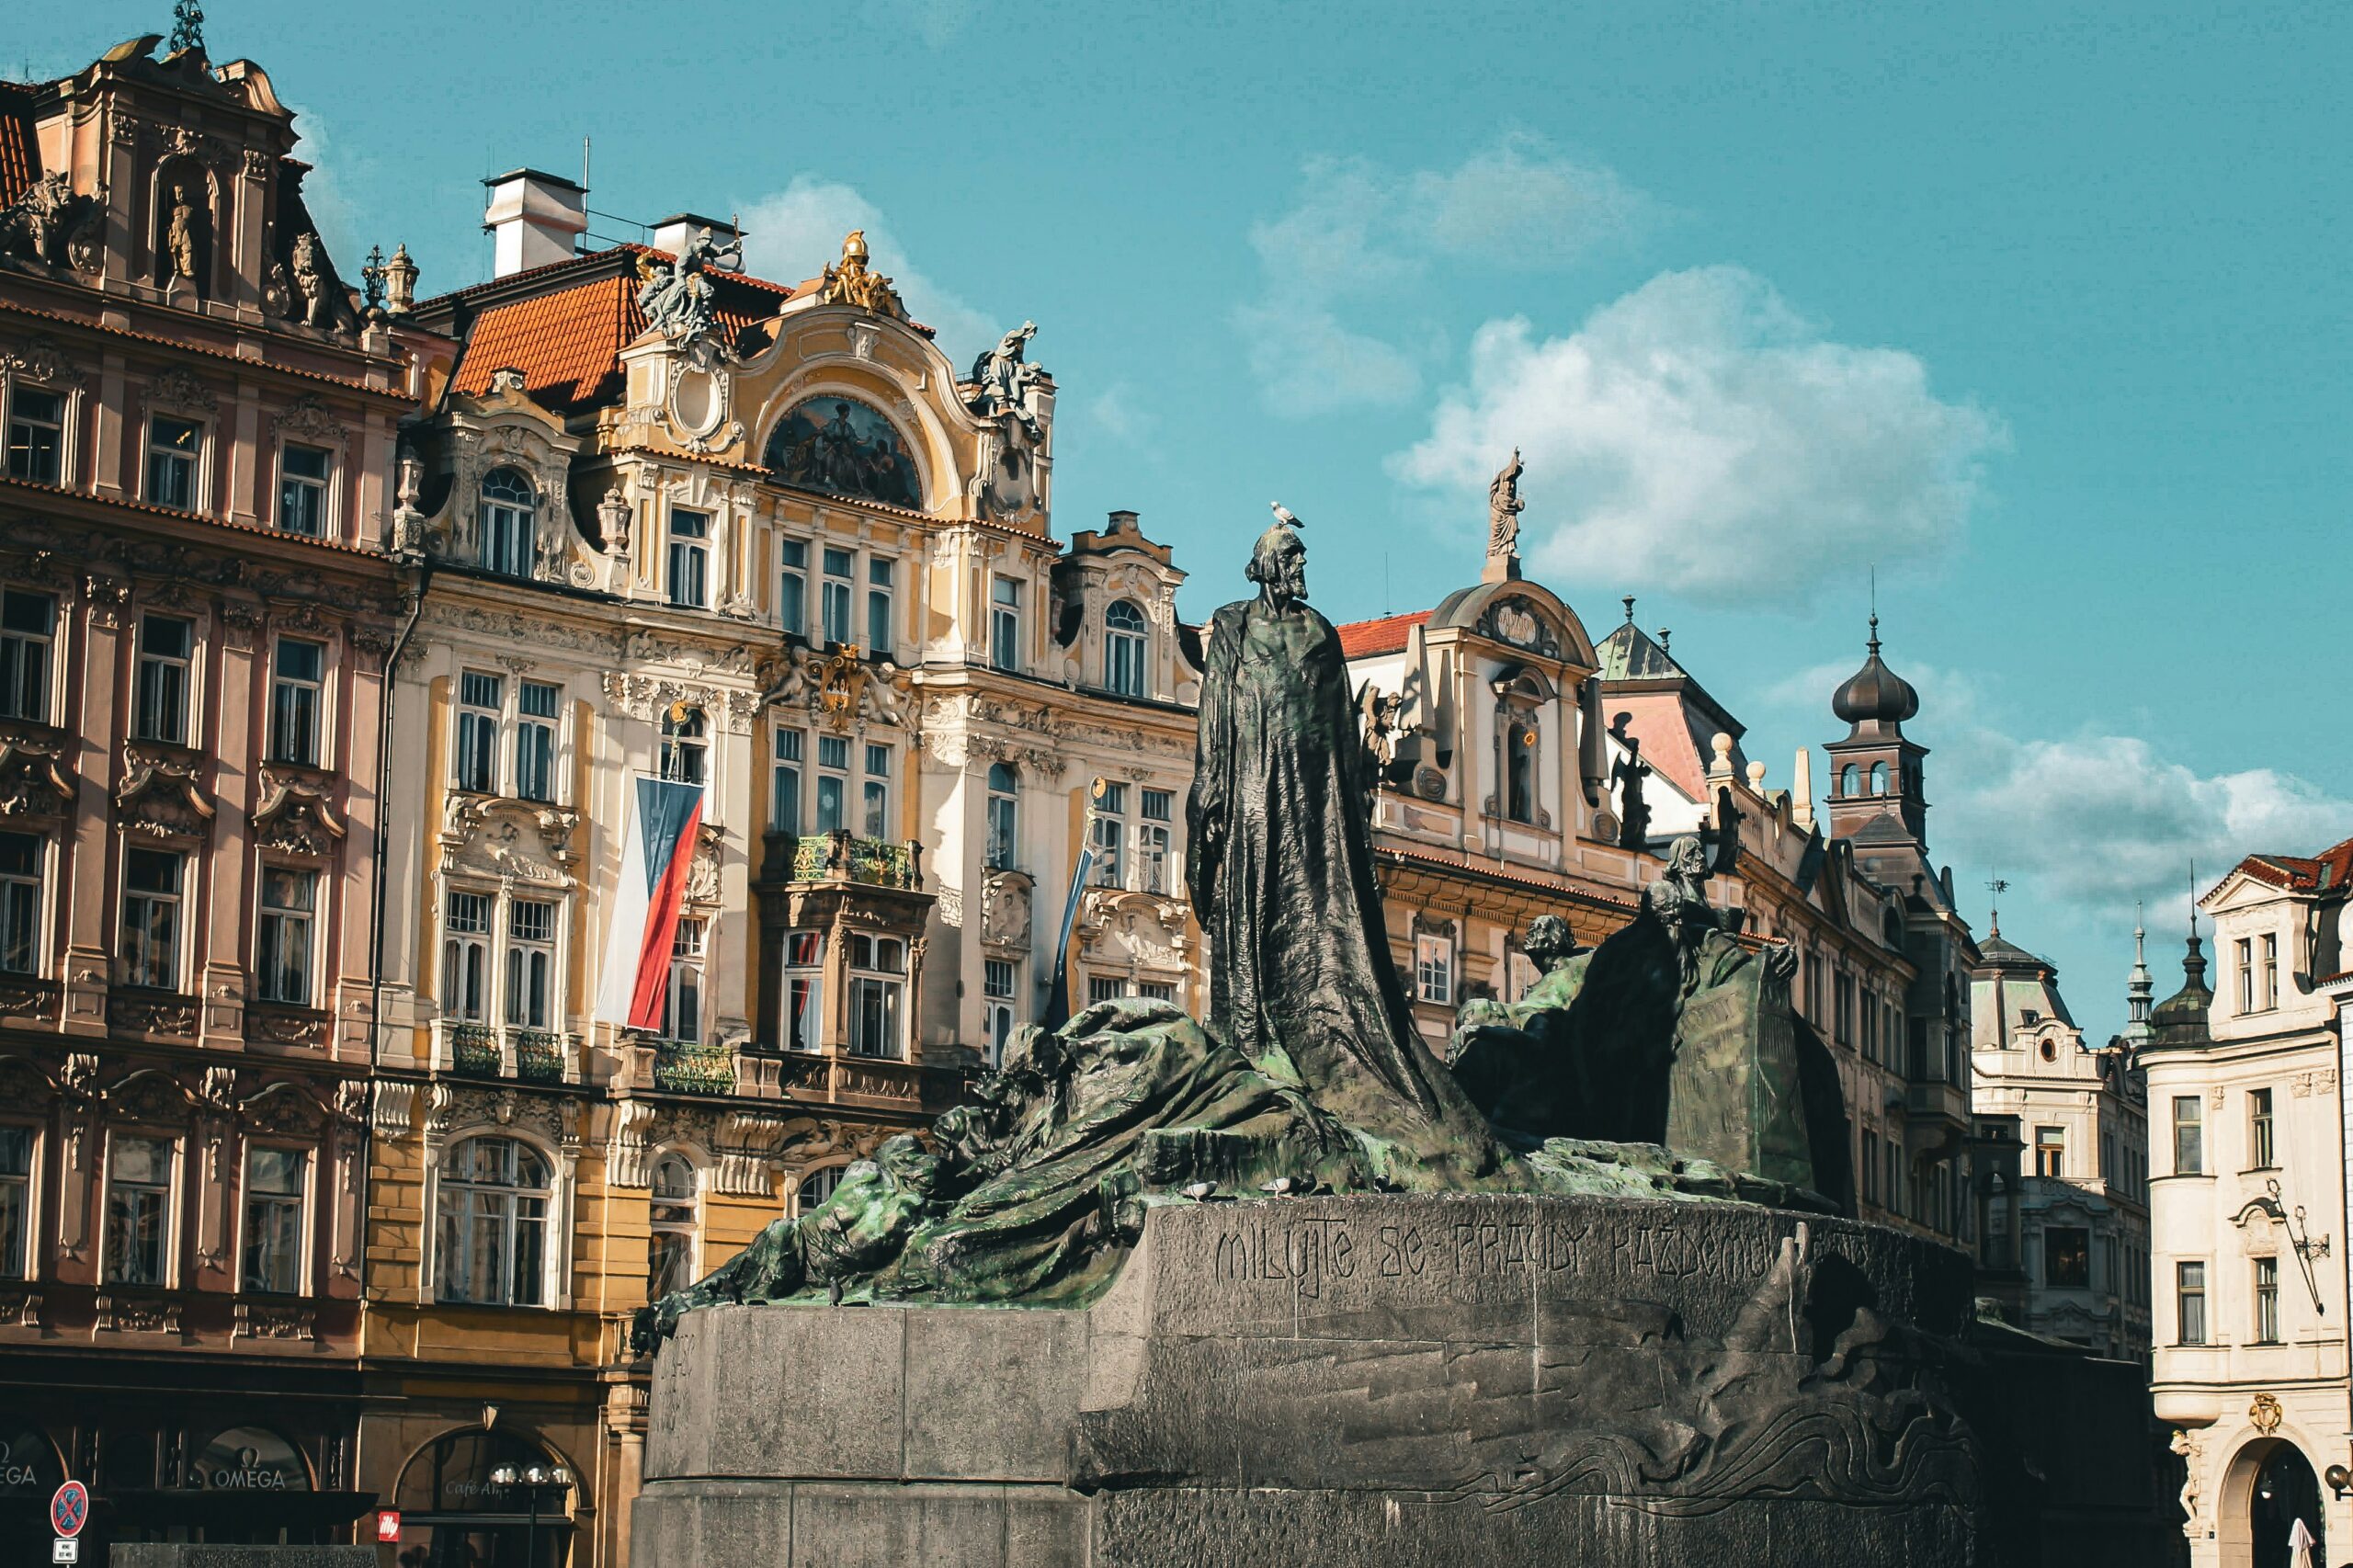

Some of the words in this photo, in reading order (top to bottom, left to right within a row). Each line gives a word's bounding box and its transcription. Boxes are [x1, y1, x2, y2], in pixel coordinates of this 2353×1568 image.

[0, 1464, 37, 1485] EGA
[216, 1470, 285, 1488] OMEGA
[446, 1480, 478, 1498] Café
[380, 1515, 399, 1540] illy
